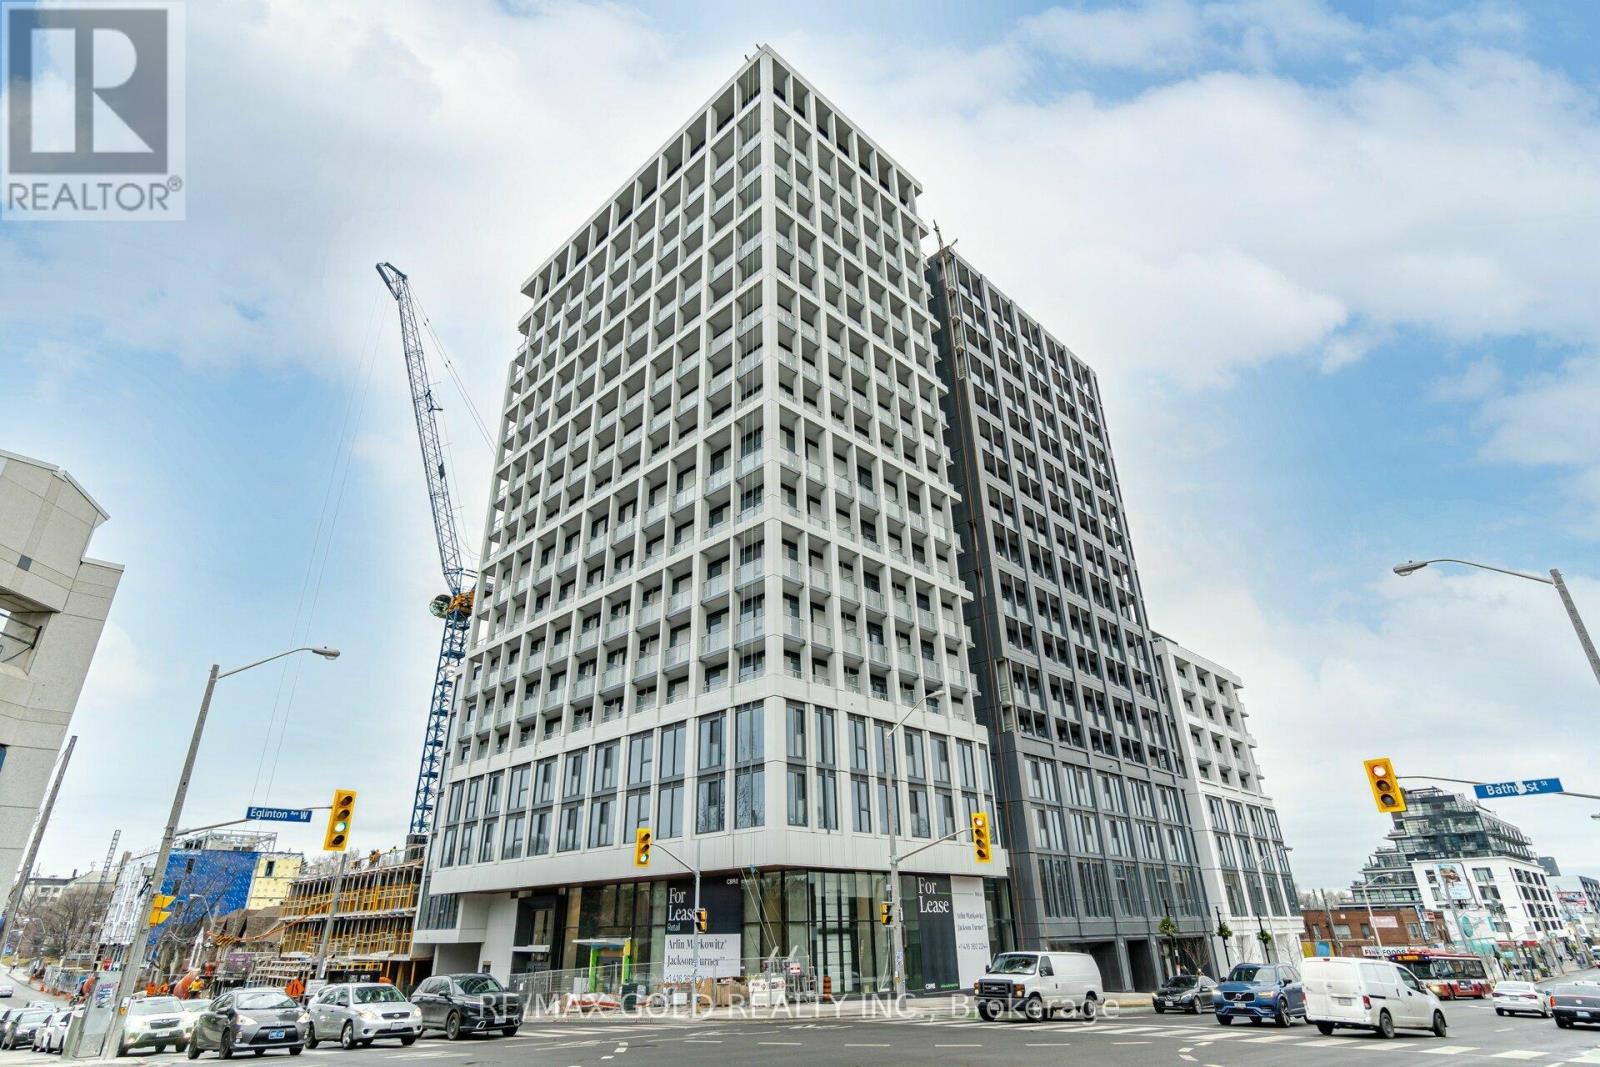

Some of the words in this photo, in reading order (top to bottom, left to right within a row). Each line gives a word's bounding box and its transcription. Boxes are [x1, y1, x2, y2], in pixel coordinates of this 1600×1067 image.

[1486, 782, 1540, 796] Bathust
[250, 808, 288, 820] Eglinton
[300, 811, 309, 820] W
[918, 877, 937, 895] For
[669, 888, 686, 904] For
[919, 896, 950, 913] Lease
[668, 939, 685, 949] Arlin
